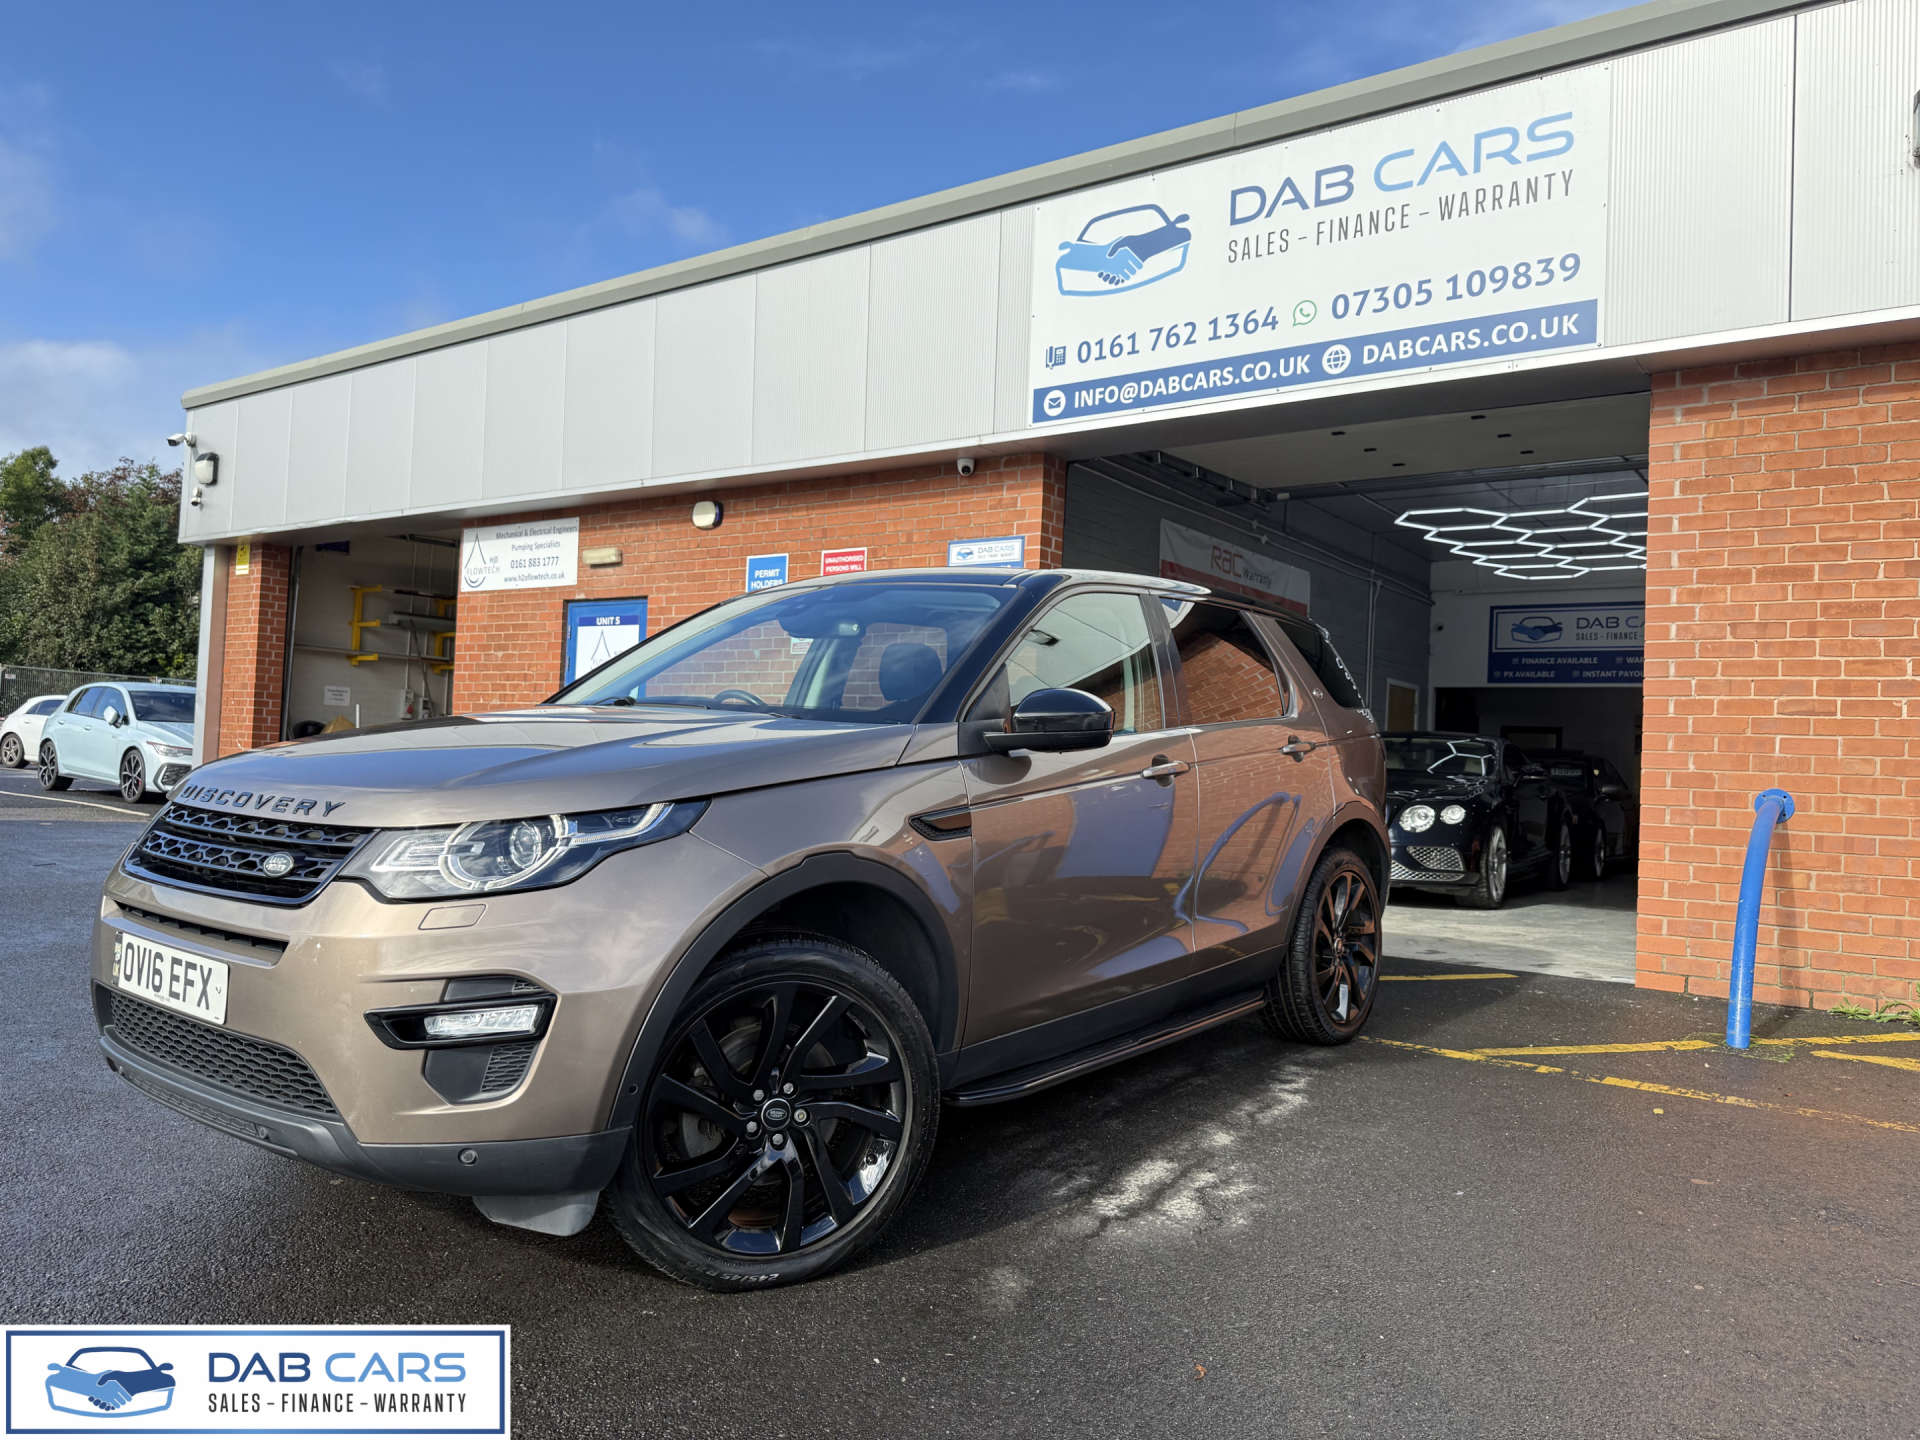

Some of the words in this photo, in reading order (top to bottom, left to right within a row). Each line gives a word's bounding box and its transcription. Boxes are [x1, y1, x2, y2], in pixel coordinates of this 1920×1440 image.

[1229, 163, 1355, 226] DAB
[1373, 111, 1575, 192] CARS
[1228, 228, 1290, 264] SALES
[1316, 203, 1411, 246] FINANCE
[1438, 169, 1574, 221] WARRANTY
[1077, 331, 1141, 364] 0161
[1149, 320, 1198, 351] 762
[1207, 305, 1279, 342] 1364
[1331, 278, 1433, 320] 07305
[1445, 252, 1582, 301] 109839
[1073, 353, 1311, 408] INFO@DABCARS.CO.UK
[1362, 313, 1580, 365] DABCARS.CO.UK
[510, 559, 527, 569] 0161
[542, 556, 560, 567] 1777
[754, 568, 780, 578] PERMIT
[596, 616, 614, 625] UNIT
[614, 616, 621, 625] 5
[1576, 616, 1620, 630] DAB
[1575, 632, 1599, 641] SALES
[1606, 631, 1639, 641] FINANCE
[1521, 657, 1555, 665] FINANCE
[1556, 656, 1598, 665] AVAILABLE
[1514, 670, 1555, 678] AVAILABLE
[1582, 670, 1616, 678] INSTANT
[180, 785, 346, 818] DISCOVERY
[123, 941, 164, 993] OV16
[168, 956, 213, 1011] EFX
